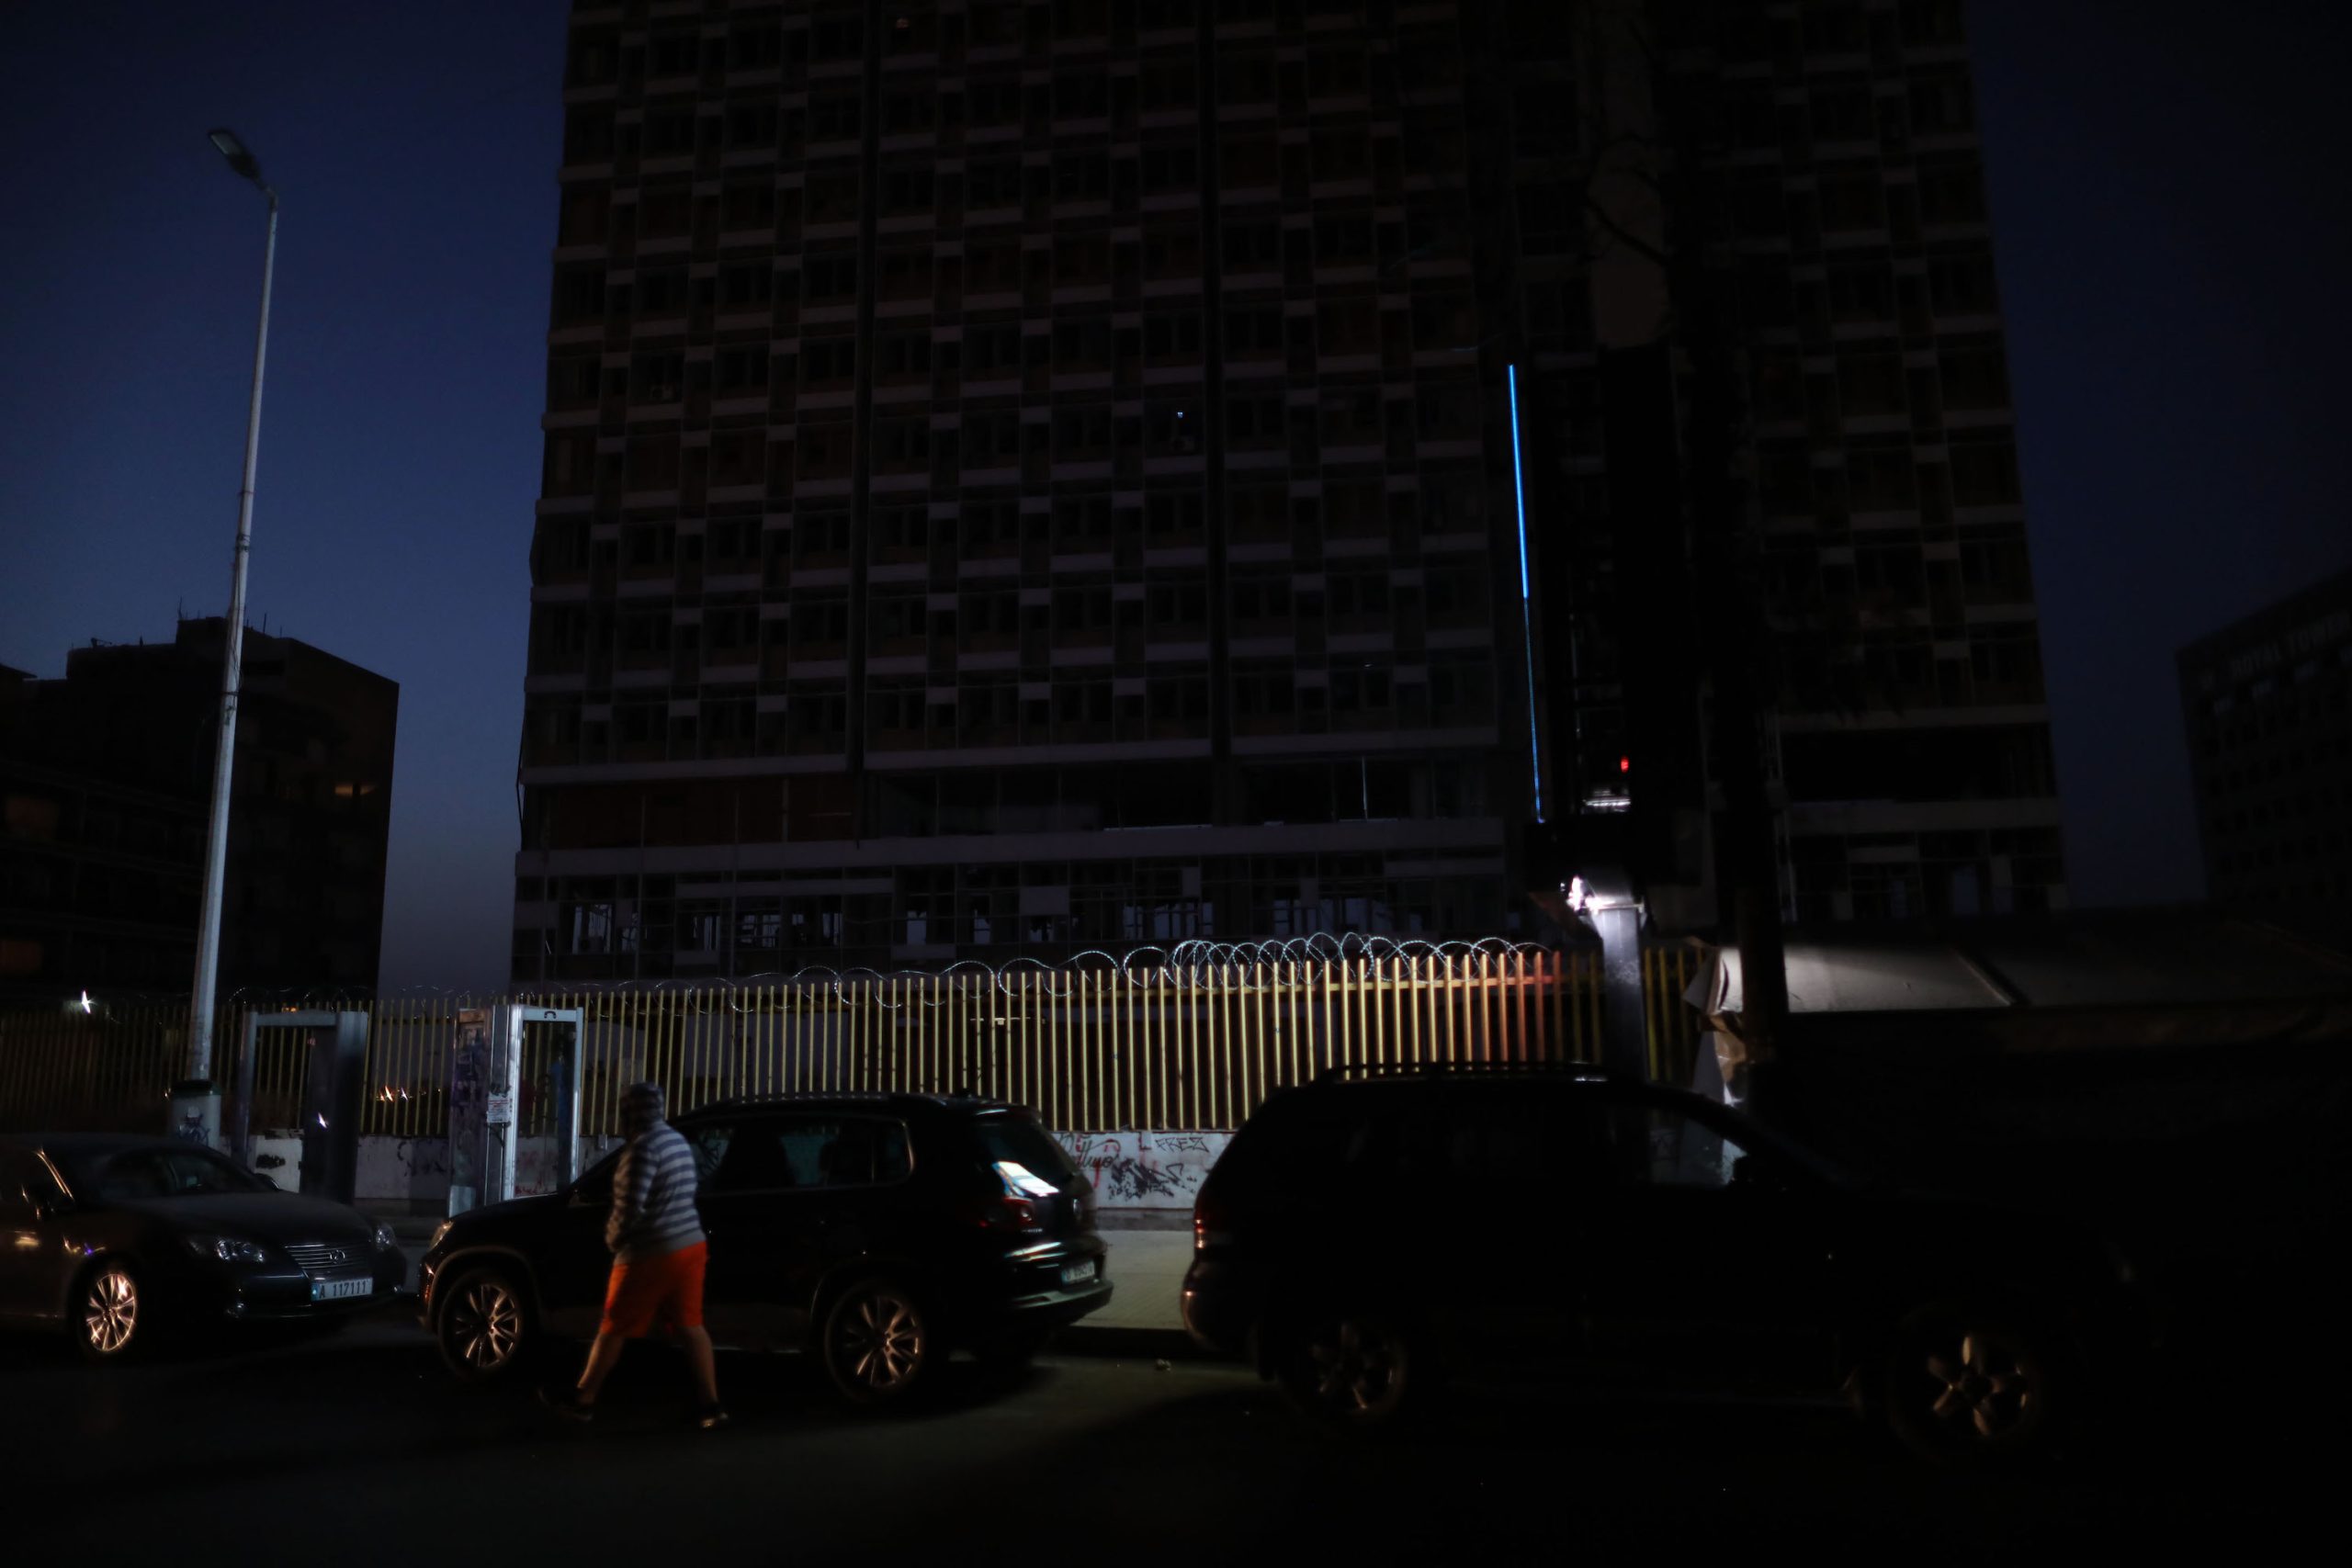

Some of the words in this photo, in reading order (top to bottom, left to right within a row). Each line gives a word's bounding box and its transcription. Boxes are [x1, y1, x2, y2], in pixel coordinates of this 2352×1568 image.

[2229, 641, 2283, 681] ROYAL
[319, 1285, 325, 1298] A
[333, 1280, 367, 1296] 117111
